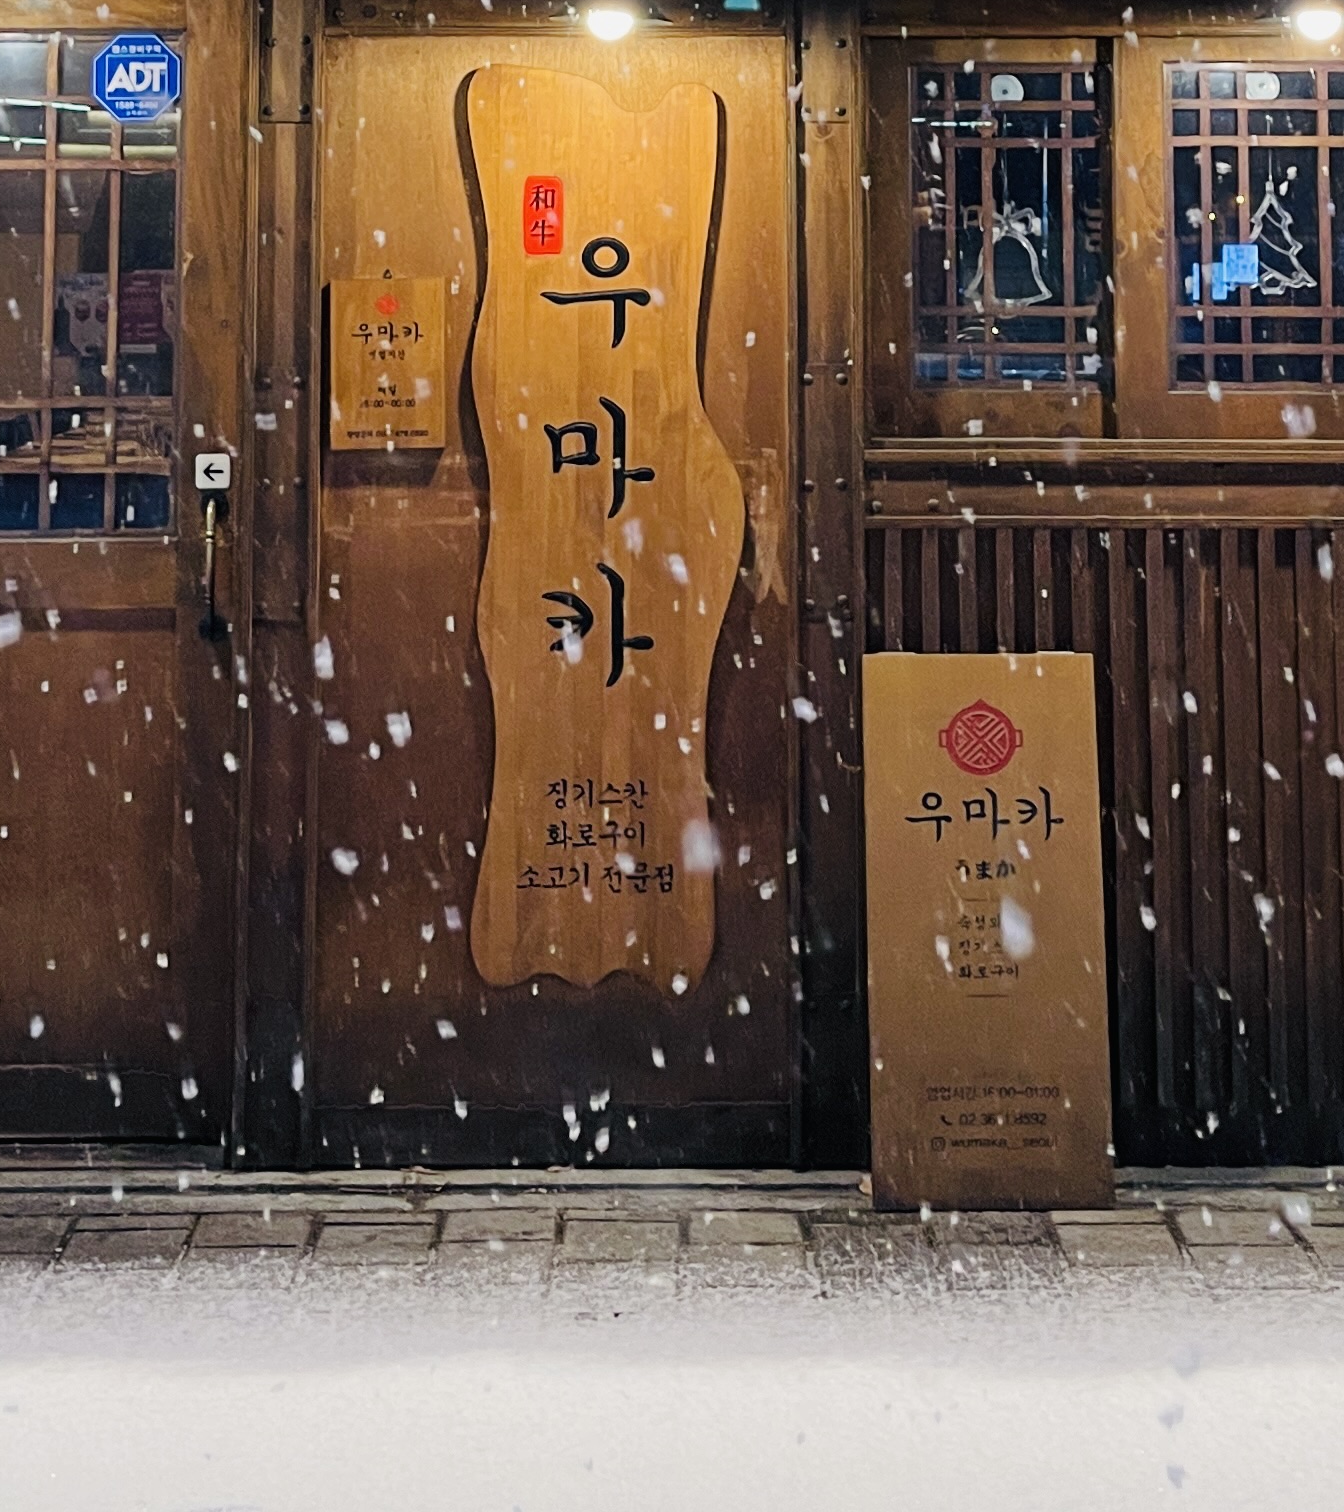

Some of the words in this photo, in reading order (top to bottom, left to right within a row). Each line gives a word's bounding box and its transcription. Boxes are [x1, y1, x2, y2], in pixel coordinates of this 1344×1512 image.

[106, 61, 167, 93] ADT
[529, 184, 556, 247] 和牛
[351, 321, 424, 345] 우마카
[541, 237, 656, 687] 우마카
[545, 778, 648, 810] 징기스칸
[905, 786, 1065, 843] 우마카
[545, 820, 646, 850] 화로구이
[516, 862, 591, 889] 소고기
[601, 861, 675, 894] 전문점
[958, 963, 1019, 979] 화로구이
